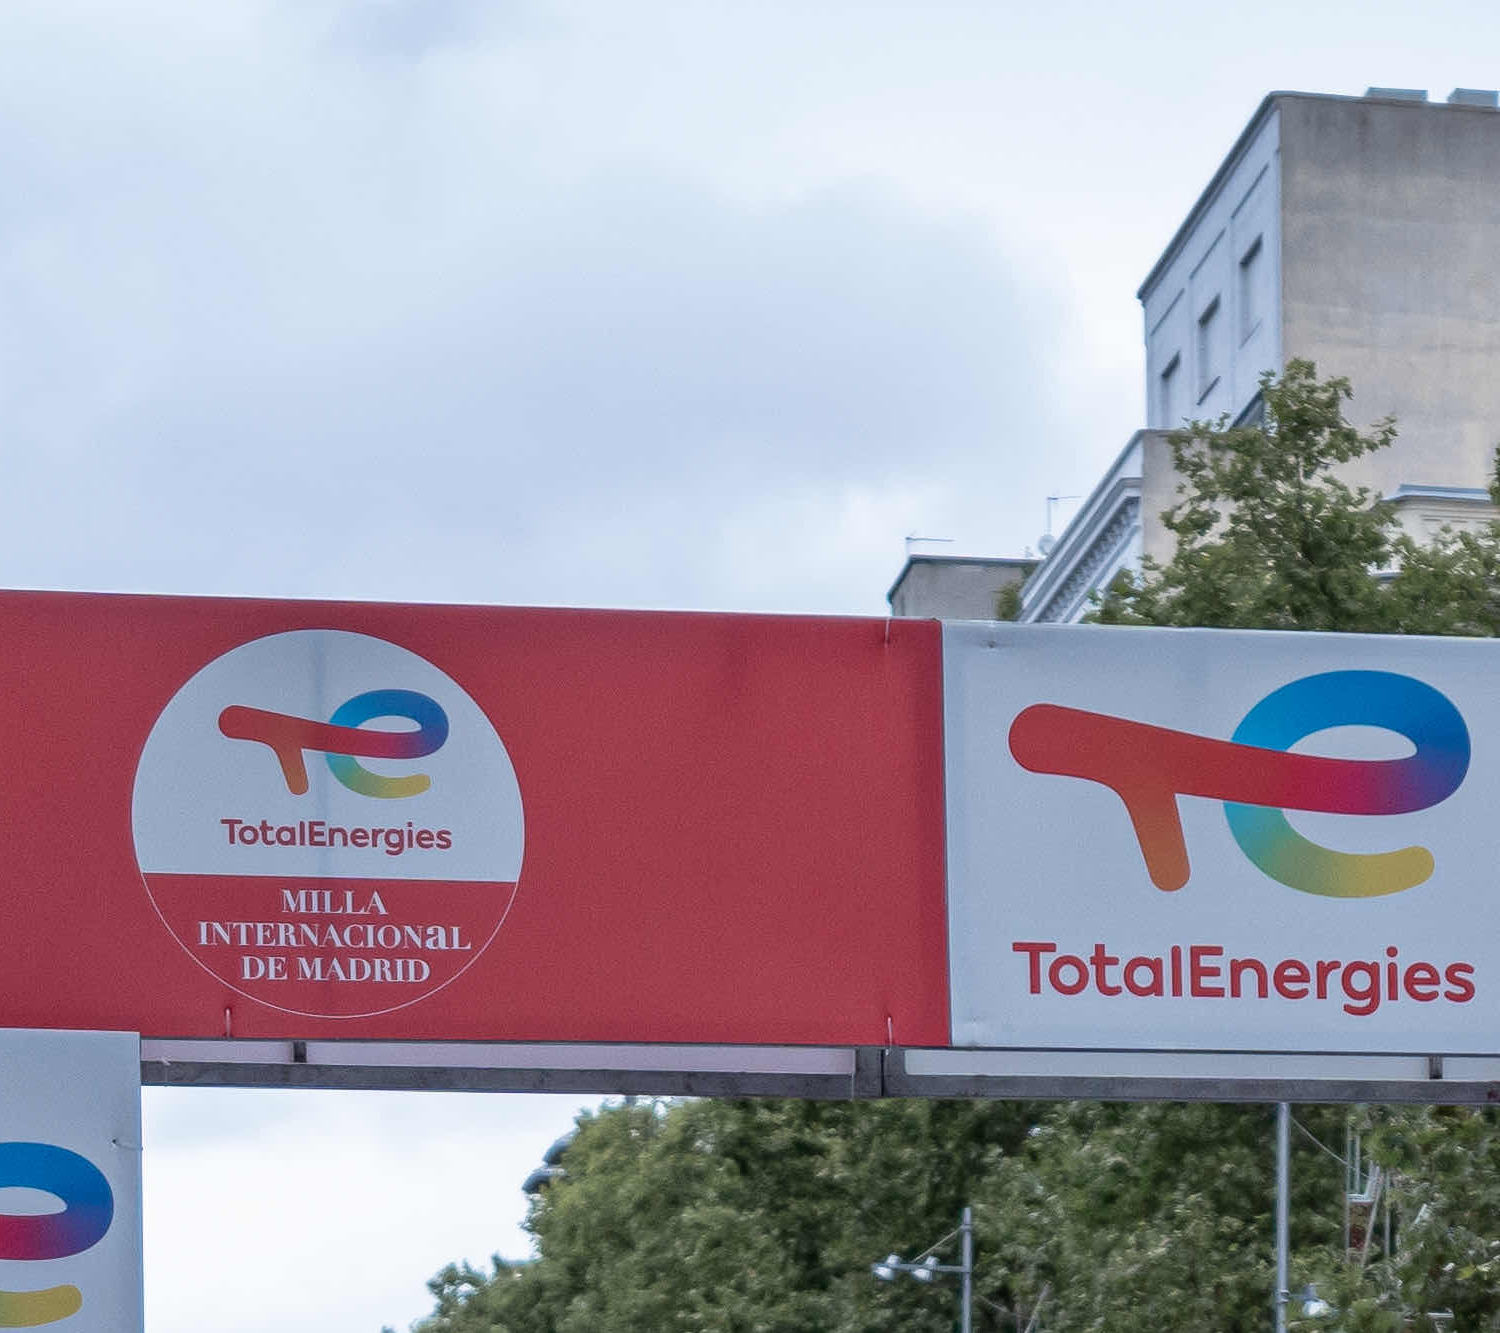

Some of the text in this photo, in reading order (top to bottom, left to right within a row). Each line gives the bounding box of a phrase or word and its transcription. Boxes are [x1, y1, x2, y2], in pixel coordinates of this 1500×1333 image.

[220, 816, 453, 857] TotalEnergies
[280, 889, 388, 918] MILLA
[241, 955, 431, 985] DE MADRID
[1012, 940, 1477, 1019] TotalEnergies
